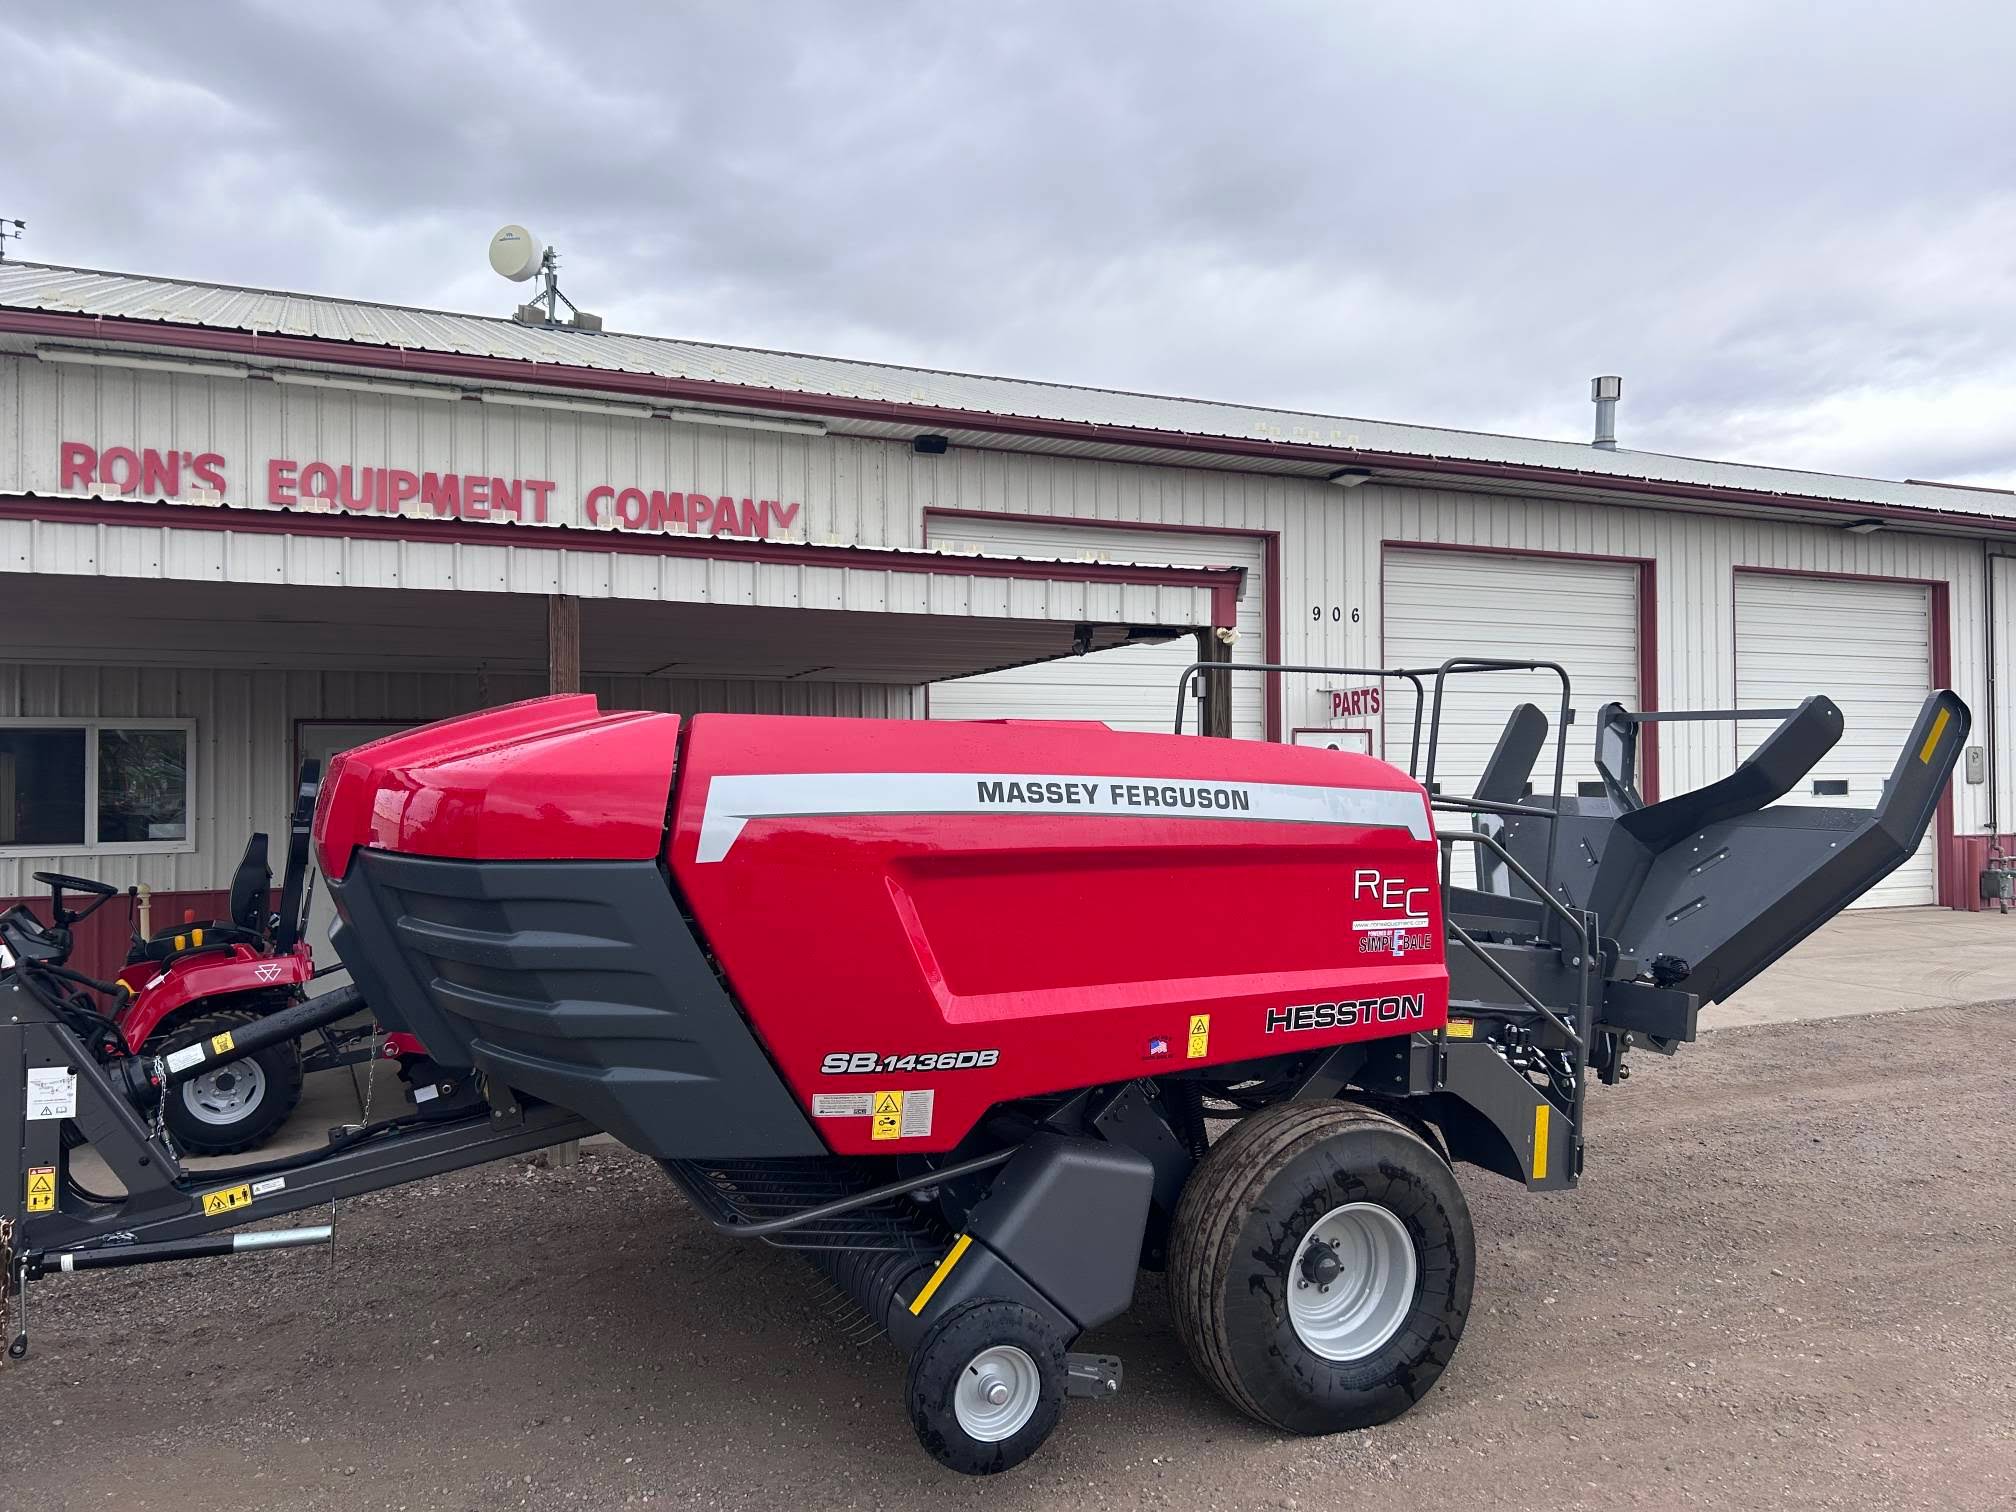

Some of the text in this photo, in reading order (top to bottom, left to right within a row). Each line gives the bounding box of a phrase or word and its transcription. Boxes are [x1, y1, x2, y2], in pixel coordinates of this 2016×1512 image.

[61, 441, 800, 538] RON'S EQUIPMENT COMPANY
[1333, 688, 1380, 717] PARTS
[977, 781, 1250, 811] MASSEY FERGUSON
[1354, 869, 1429, 917] REC
[1265, 993, 1425, 1034] HESSTON
[821, 1050, 1000, 1074] SB.1436DB
